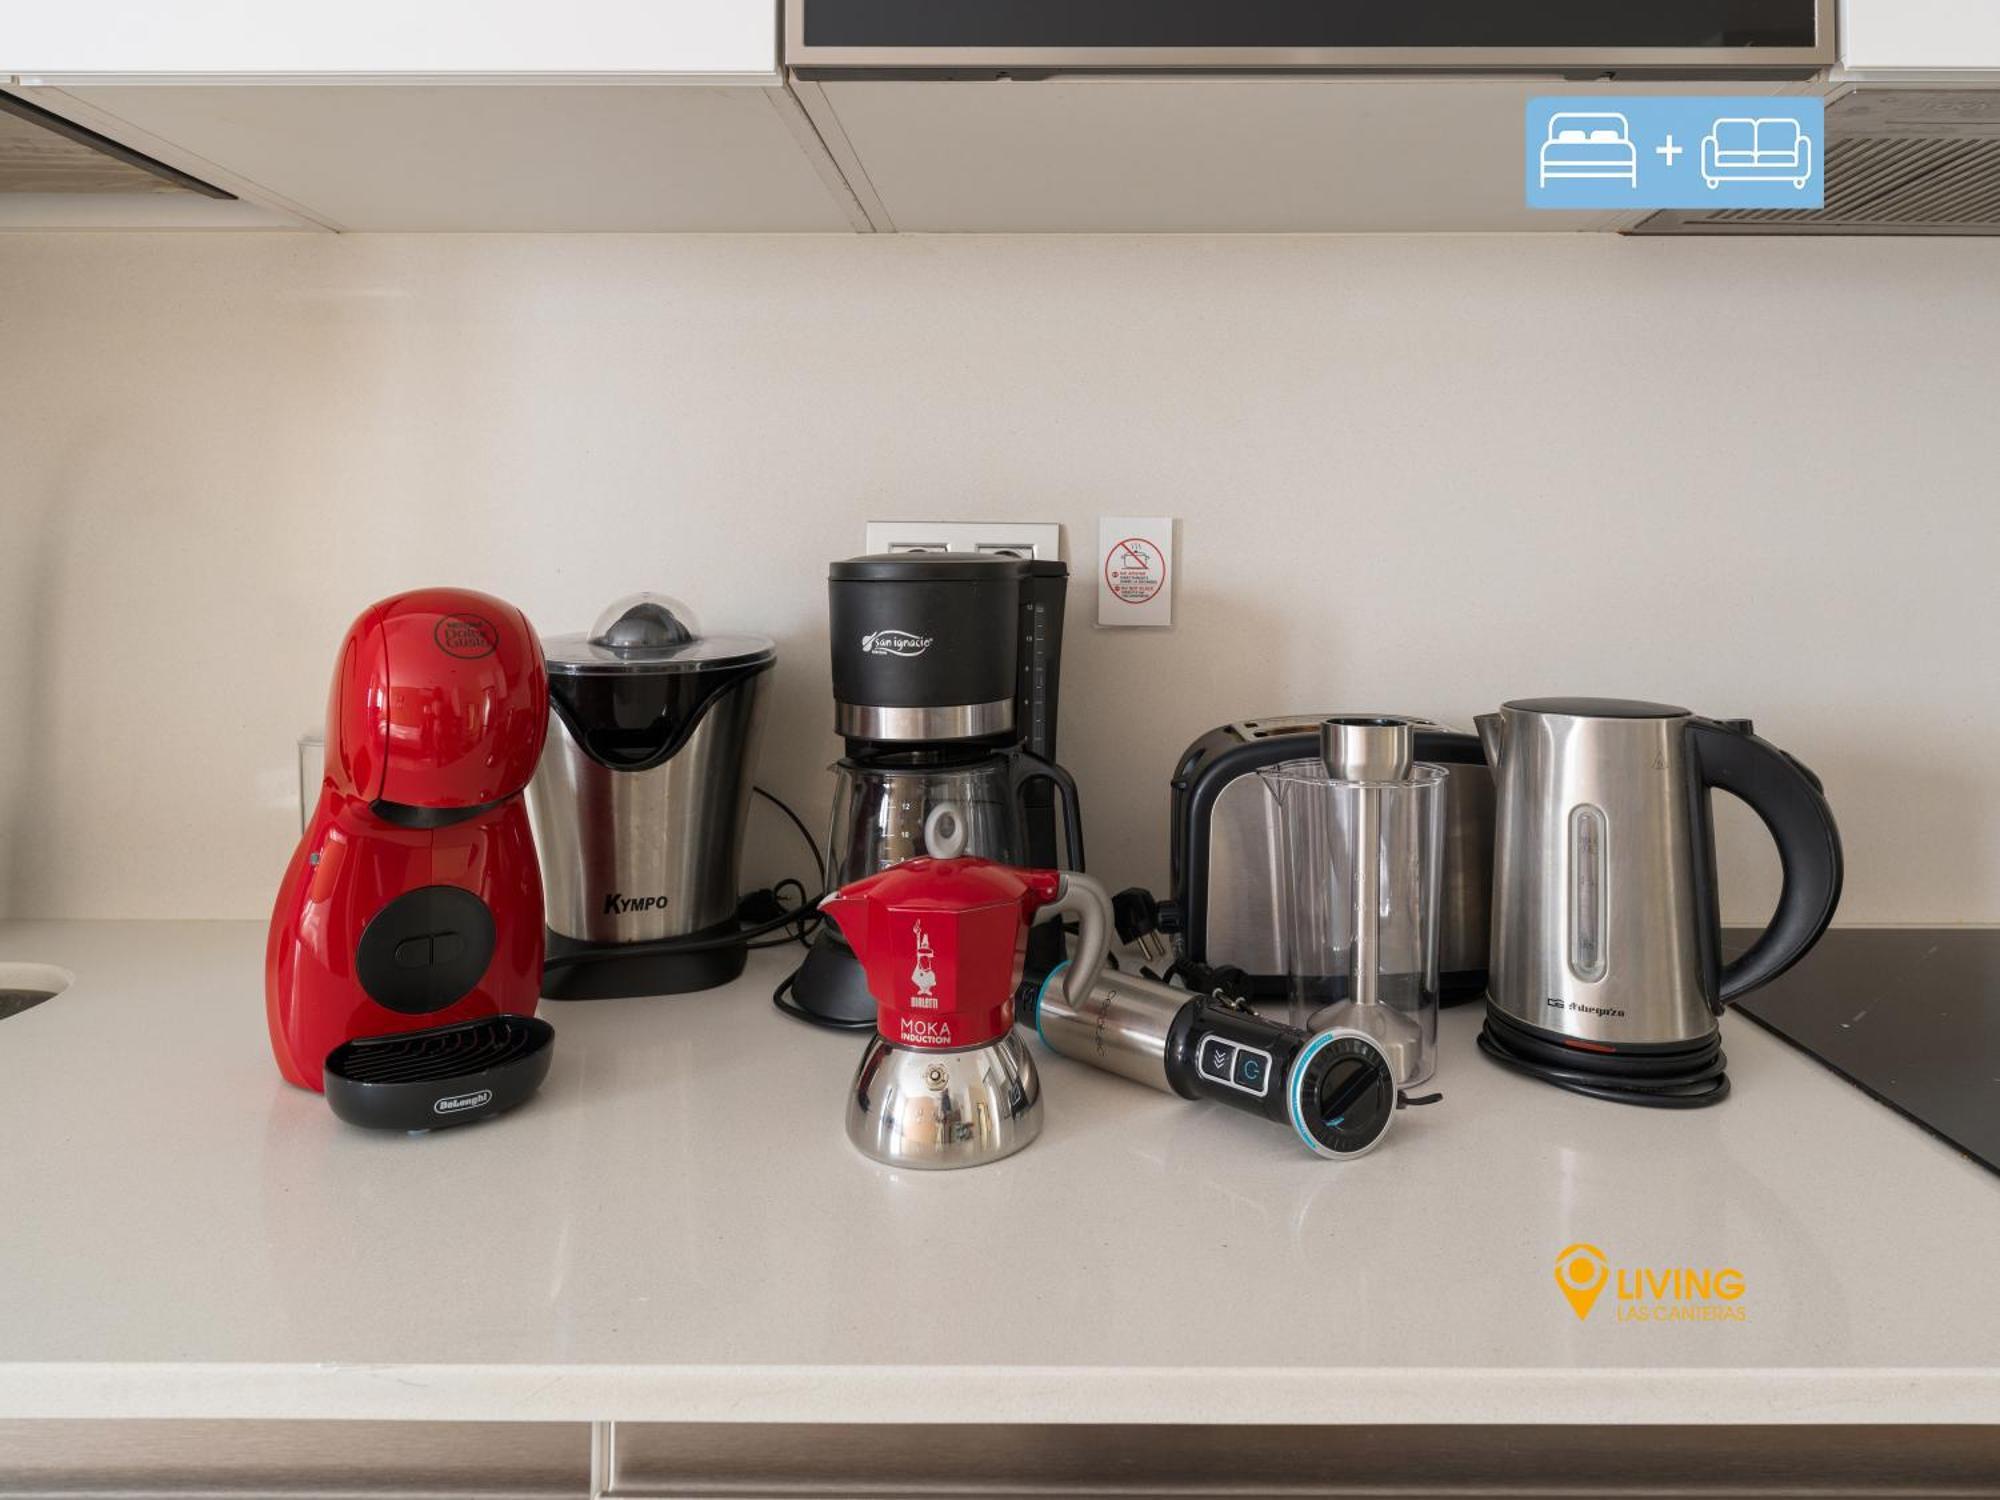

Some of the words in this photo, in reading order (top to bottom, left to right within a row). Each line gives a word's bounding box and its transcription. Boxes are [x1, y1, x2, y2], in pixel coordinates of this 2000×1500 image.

[875, 638, 892, 648] san
[603, 893, 668, 914] KYMPO
[901, 1018, 951, 1036] MOKA
[901, 1032, 952, 1044] INDUCTION
